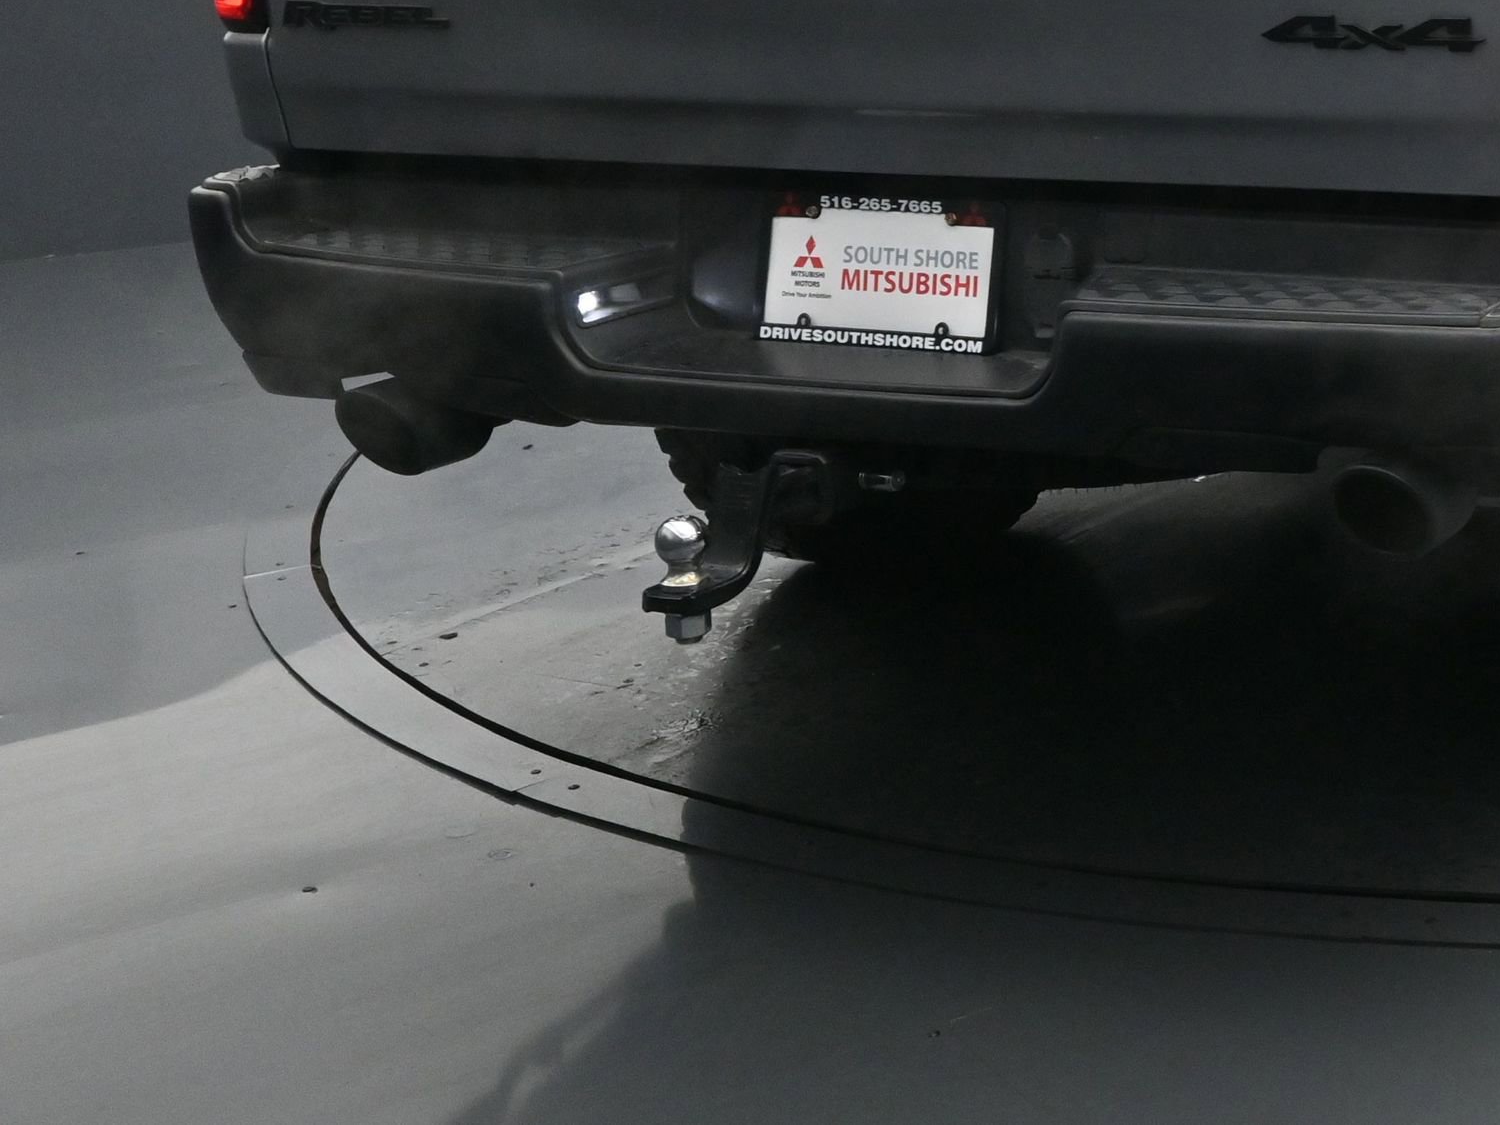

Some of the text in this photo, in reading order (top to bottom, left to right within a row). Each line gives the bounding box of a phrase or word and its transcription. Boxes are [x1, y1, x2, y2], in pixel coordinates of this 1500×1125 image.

[820, 195, 942, 214] 516-265-7665
[843, 245, 979, 270] SOUTH SHORE
[791, 270, 825, 278] MITSUBISHI
[841, 268, 979, 297] MITSUBISHI
[759, 325, 983, 353] DRIVESOUTHSHORE.COM
